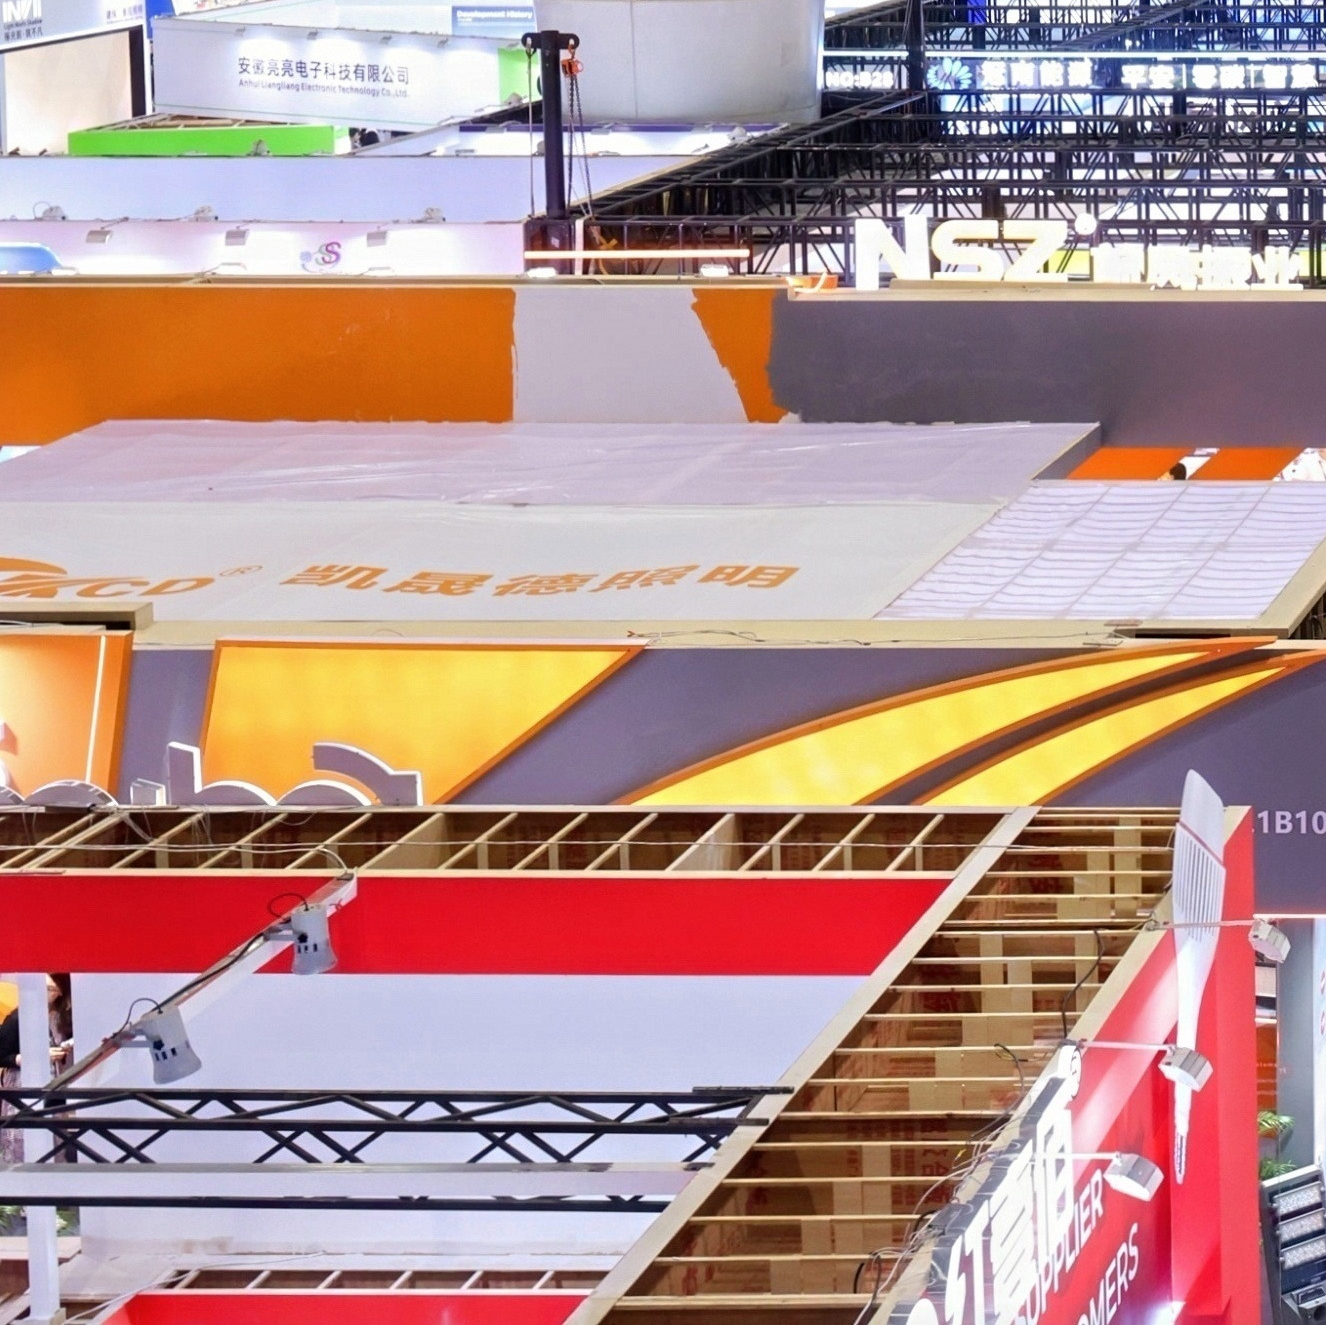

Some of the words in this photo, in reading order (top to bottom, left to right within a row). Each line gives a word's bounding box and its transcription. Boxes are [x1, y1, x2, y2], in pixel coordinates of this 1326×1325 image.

[238, 57, 409, 85] 安徽亮亮电子科技有限公司
[280, 564, 801, 598] 凯晟德照明
